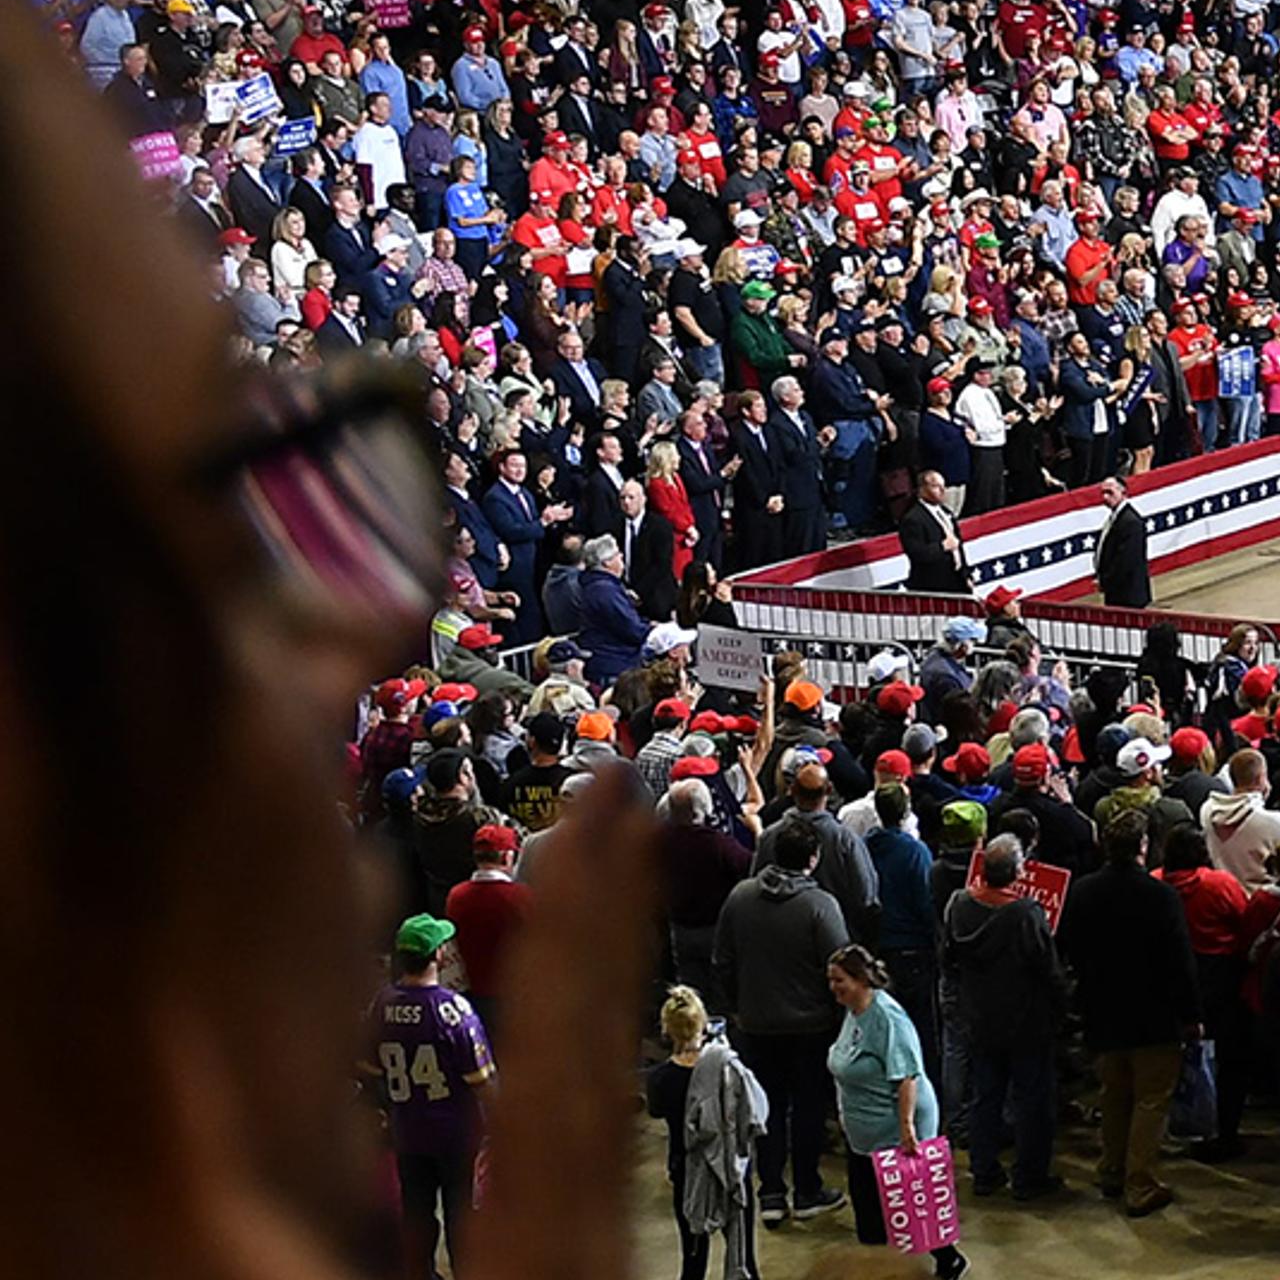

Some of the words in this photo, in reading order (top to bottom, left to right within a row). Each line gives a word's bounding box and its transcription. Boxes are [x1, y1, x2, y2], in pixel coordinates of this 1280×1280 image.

[702, 649, 761, 669] AMERICA
[378, 1041, 451, 1103] 84
[878, 1149, 914, 1253] WOMEN
[910, 1178, 929, 1218] FOR
[924, 1145, 955, 1239] TRUMP
